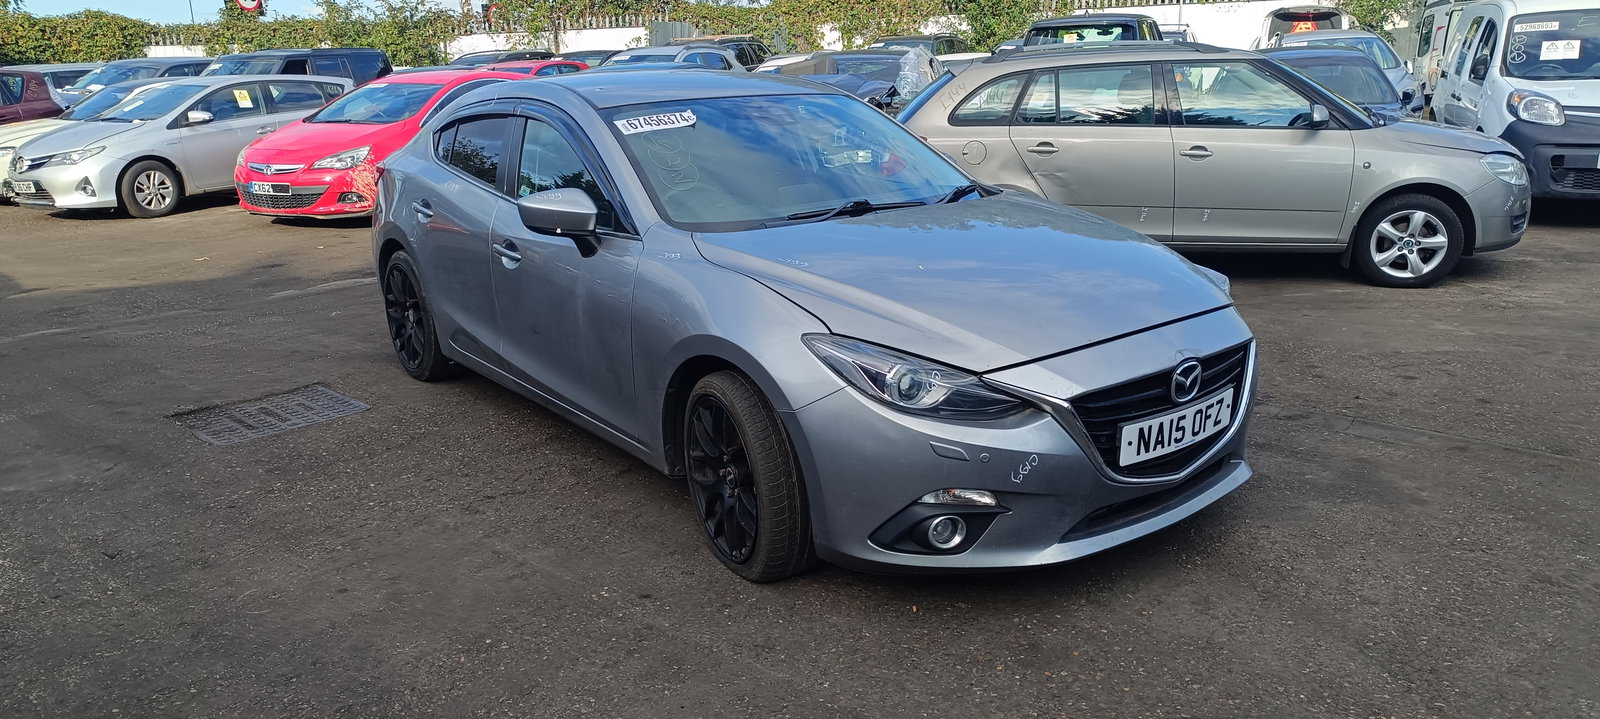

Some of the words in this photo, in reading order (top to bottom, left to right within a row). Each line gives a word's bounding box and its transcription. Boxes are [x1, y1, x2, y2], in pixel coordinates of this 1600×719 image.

[626, 113, 689, 130] 67456374
[253, 182, 272, 193] CX62
[1191, 397, 1225, 437] OFZ
